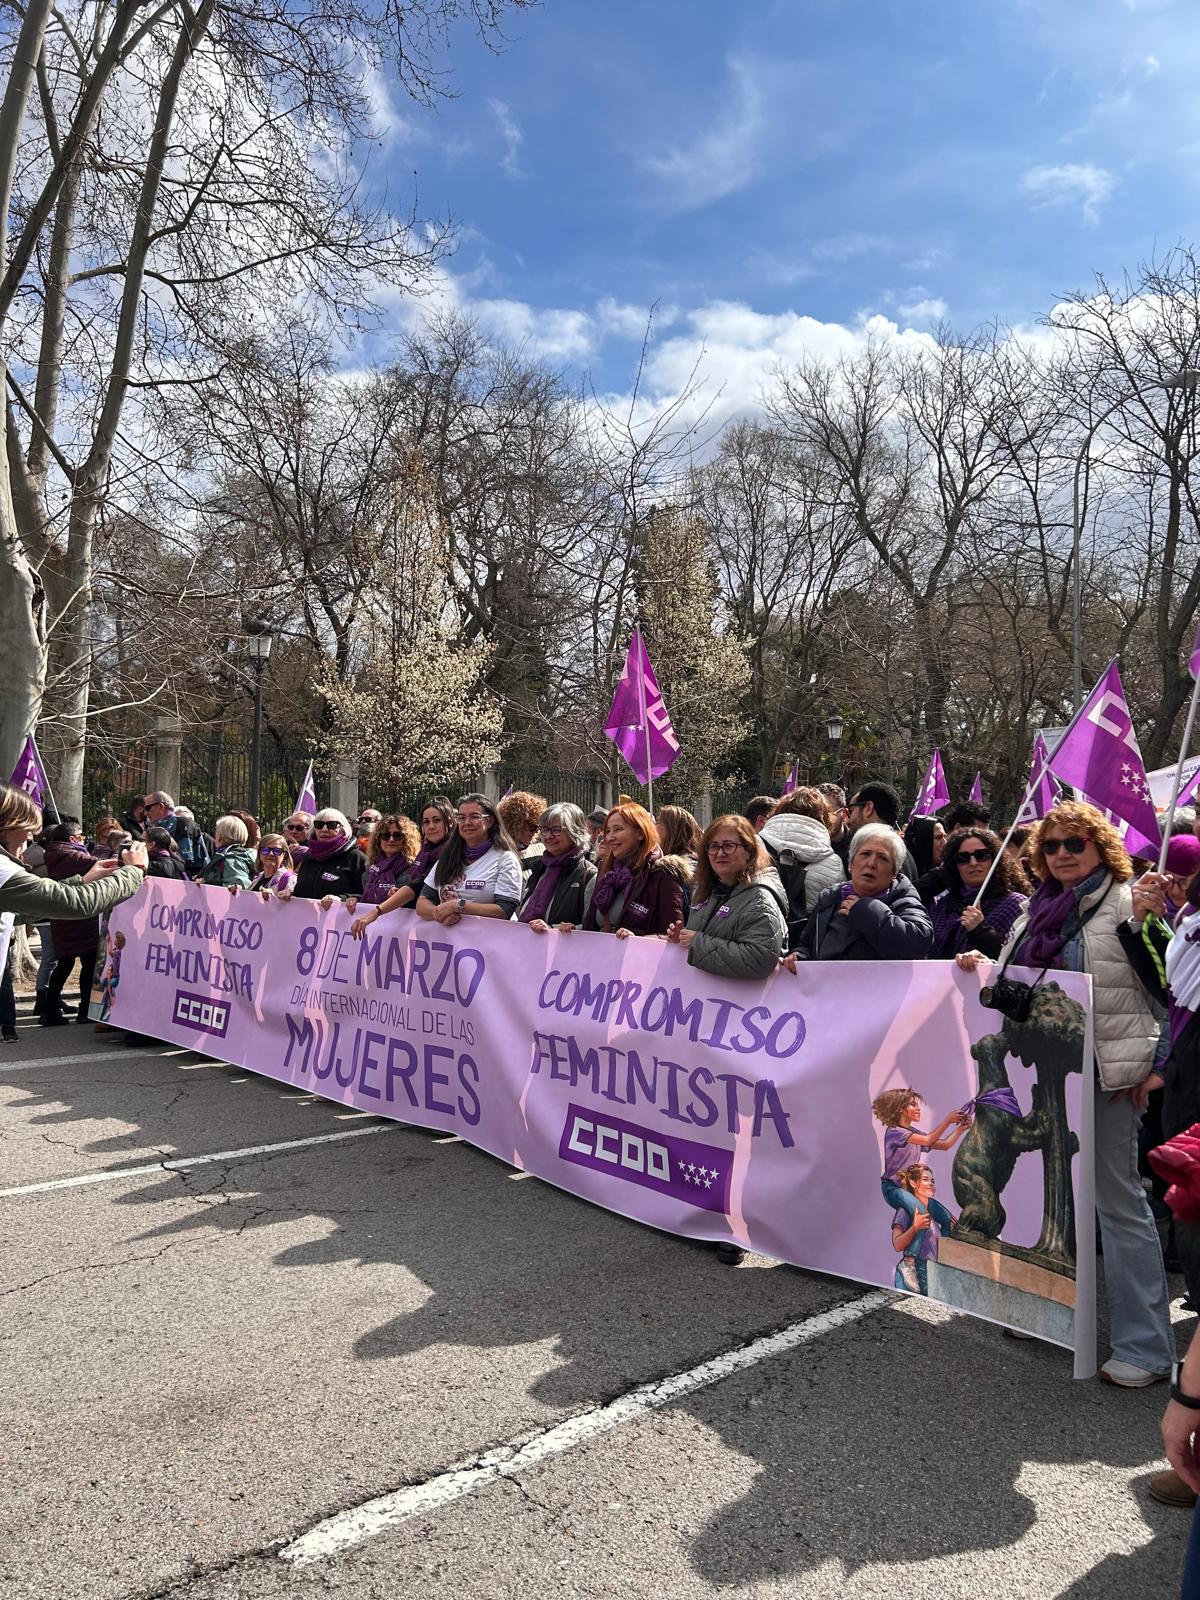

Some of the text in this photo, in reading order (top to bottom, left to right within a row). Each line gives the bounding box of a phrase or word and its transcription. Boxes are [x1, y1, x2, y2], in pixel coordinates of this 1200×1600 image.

[150, 903, 264, 951] COMPROMISO
[144, 942, 254, 1002] FEMINISTA
[296, 926, 486, 1008] 8 DE MARZO
[176, 997, 227, 1030] CCOO
[290, 983, 475, 1046] DÍA INTERNACIONAL DE LAS
[538, 970, 807, 1059] COMPROMISO
[283, 1013, 481, 1126] MUJERES
[530, 1031, 795, 1148] FEMINISTA
[568, 1116, 671, 1183] CCOO
